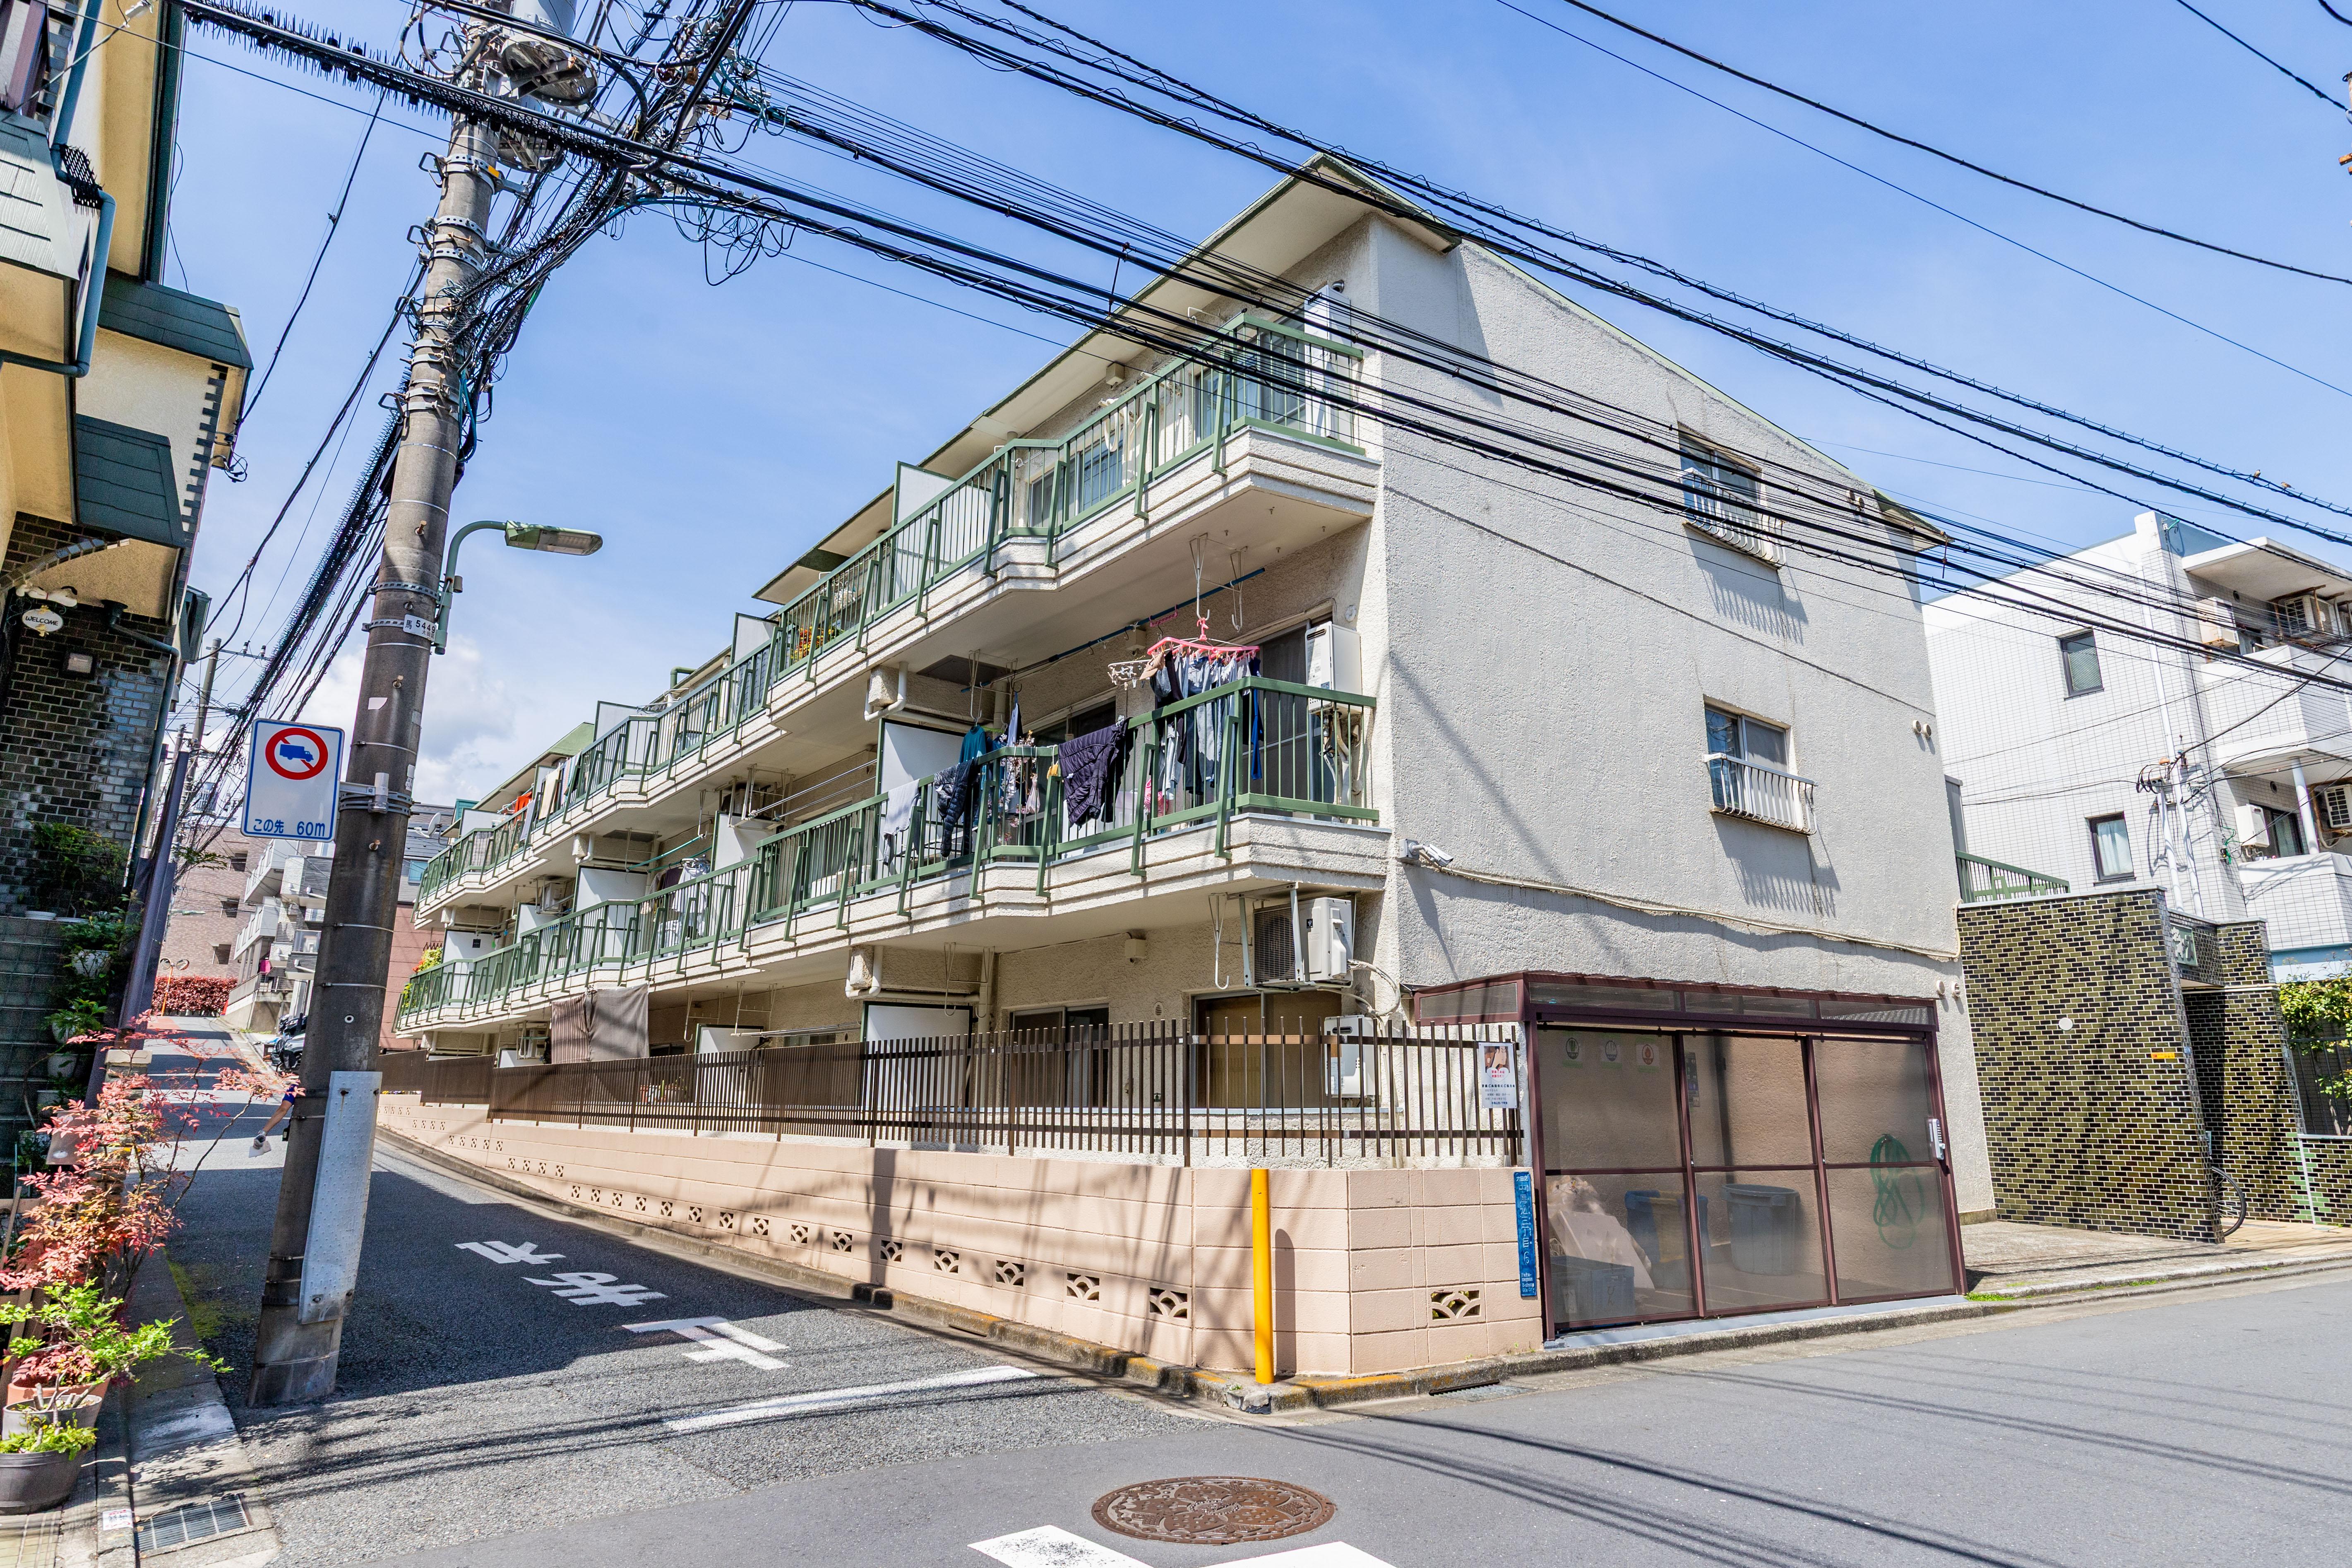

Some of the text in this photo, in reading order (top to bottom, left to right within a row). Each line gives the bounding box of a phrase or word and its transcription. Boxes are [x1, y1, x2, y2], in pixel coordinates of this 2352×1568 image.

[25, 616, 58, 625] WELCOME
[406, 620, 435, 634] 馬 5449
[422, 630, 435, 639] 大田区
[253, 819, 325, 836] この先 60m
[1519, 1183, 1530, 1248] 中馬込三丁目
[1524, 1251, 1530, 1264] 6
